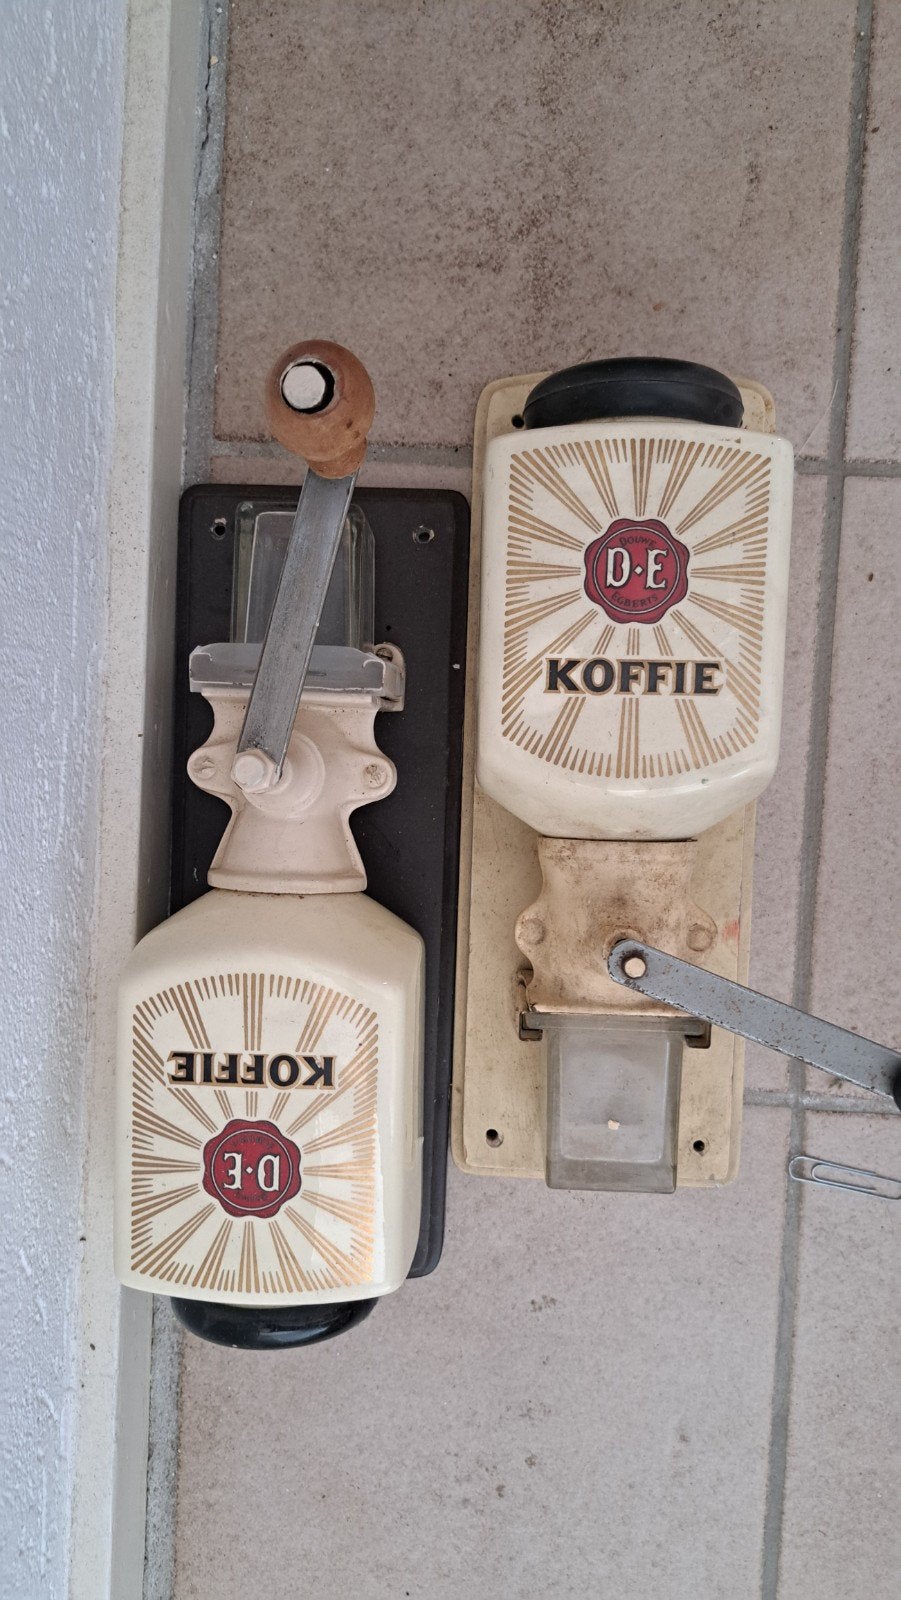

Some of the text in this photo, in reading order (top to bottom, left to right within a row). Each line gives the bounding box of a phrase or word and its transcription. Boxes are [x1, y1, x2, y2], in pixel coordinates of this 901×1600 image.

[619, 536, 657, 548] DOUWE
[544, 657, 726, 696] KOFFIE
[167, 1051, 336, 1090] KOFFIE
